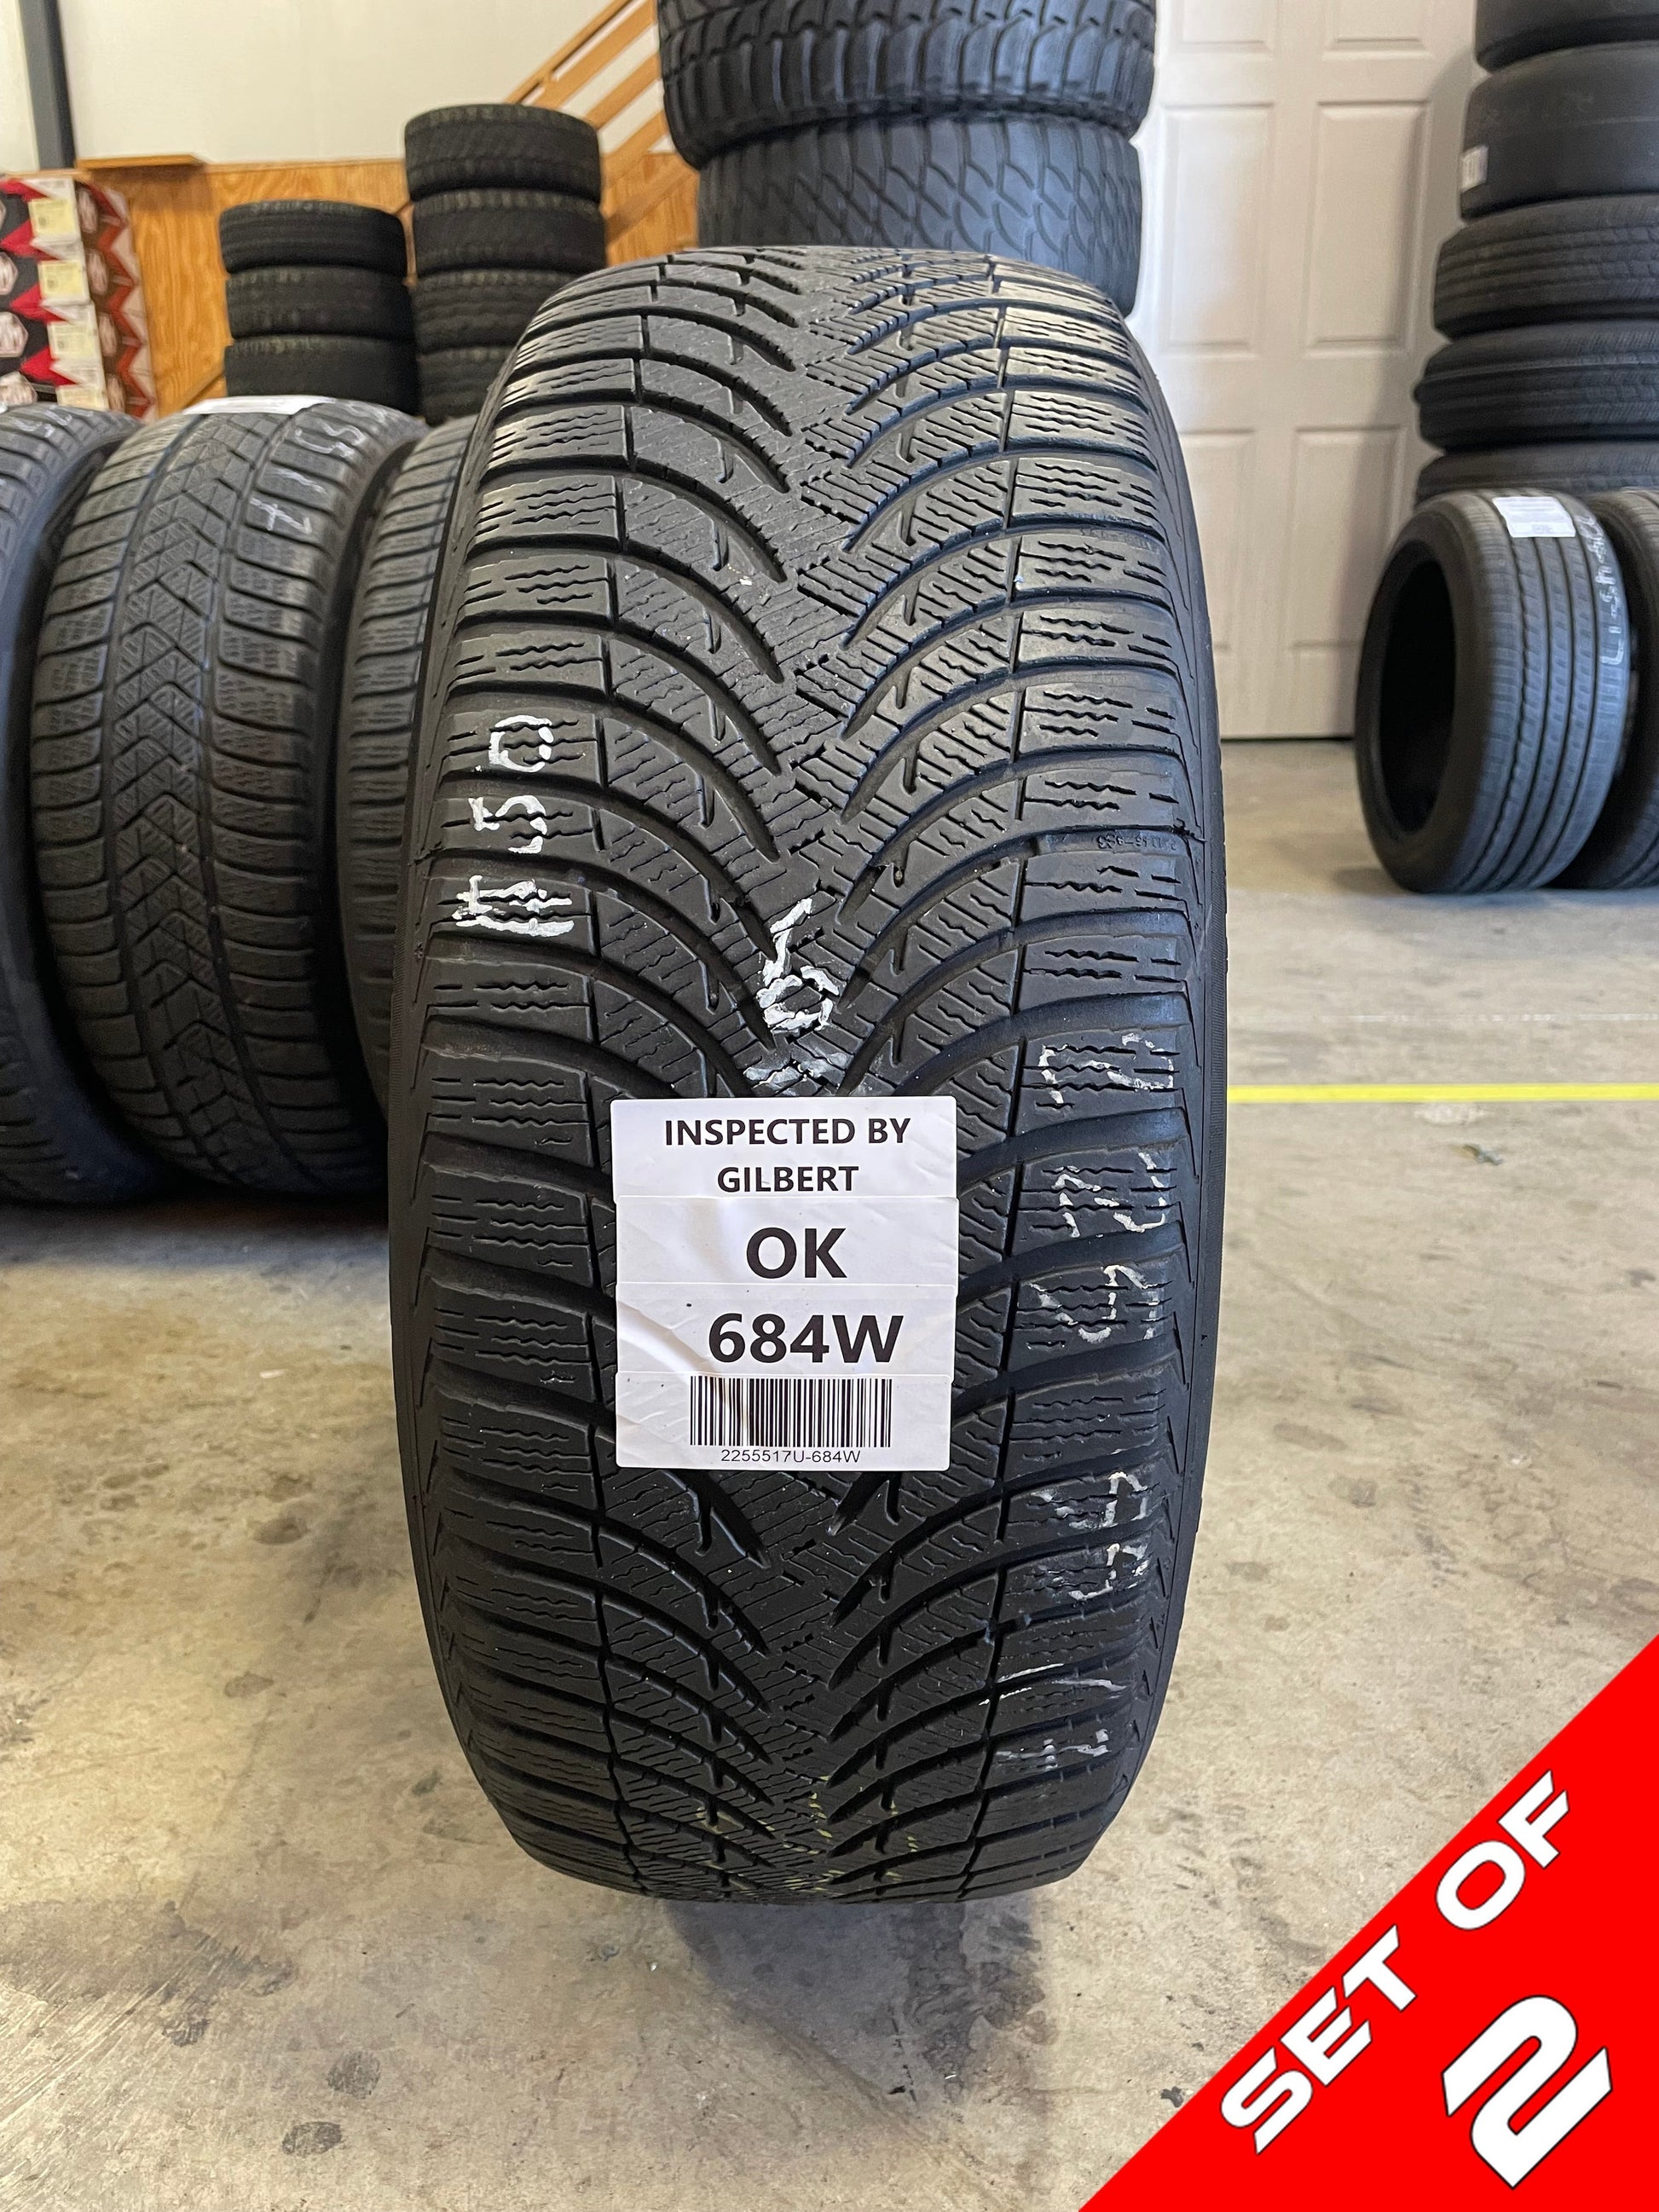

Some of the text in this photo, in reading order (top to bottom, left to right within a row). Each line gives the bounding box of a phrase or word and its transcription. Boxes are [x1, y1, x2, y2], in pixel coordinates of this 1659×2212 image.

[665, 1118, 911, 1146] INSPECTED BY
[717, 1165, 859, 1193] GILBERT
[746, 1227, 847, 1279] OK
[708, 1312, 905, 1364] 684W
[720, 1448, 861, 1464] 2255517U-684W
